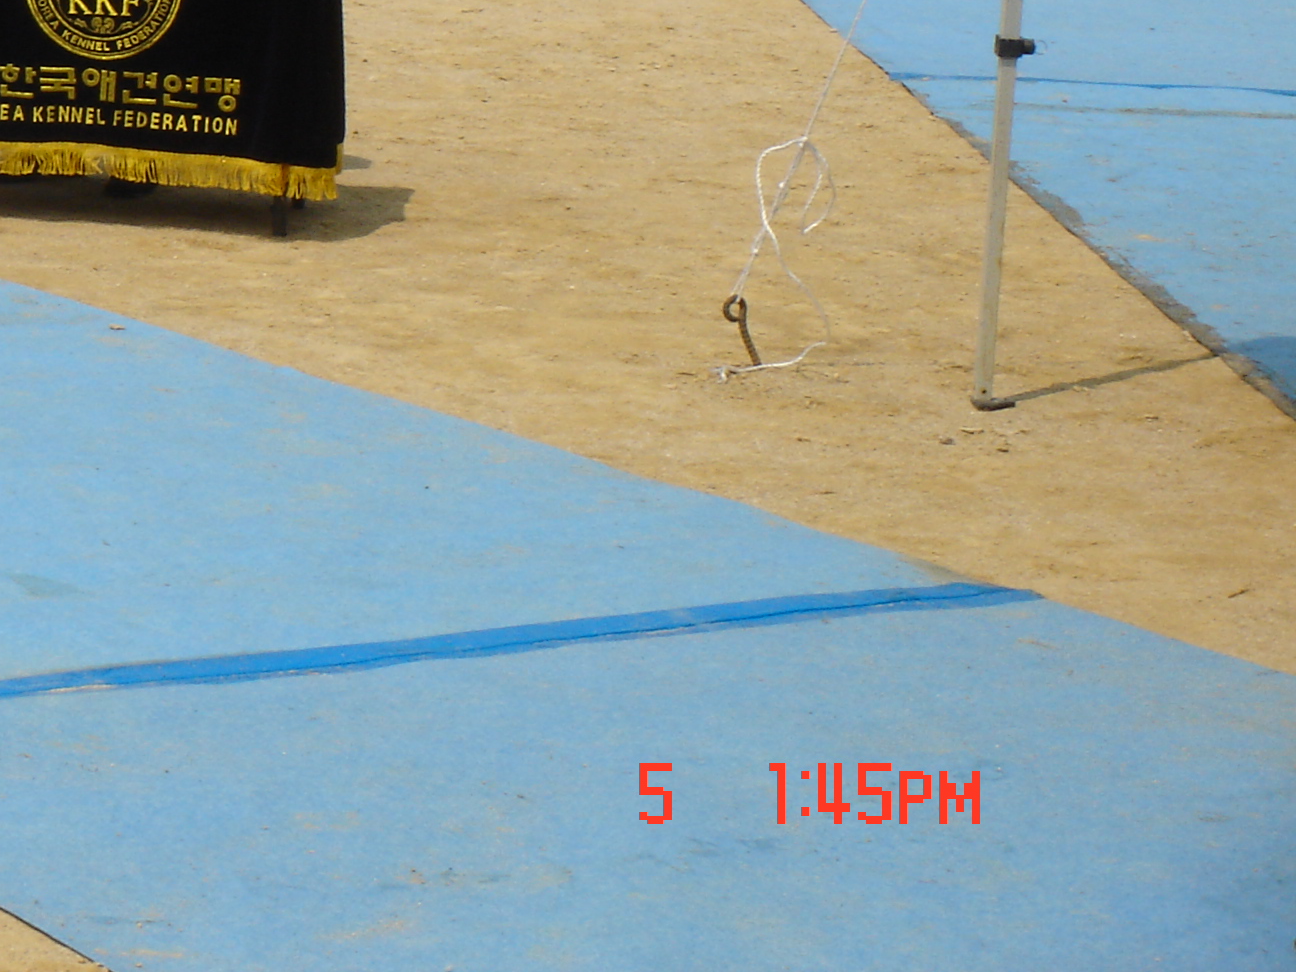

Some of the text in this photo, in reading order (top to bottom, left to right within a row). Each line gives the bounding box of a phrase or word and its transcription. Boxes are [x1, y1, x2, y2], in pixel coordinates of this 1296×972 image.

[61, 29, 110, 52] KENNEL
[32, 105, 105, 126] KENNEL
[112, 109, 238, 136] FEDERATION
